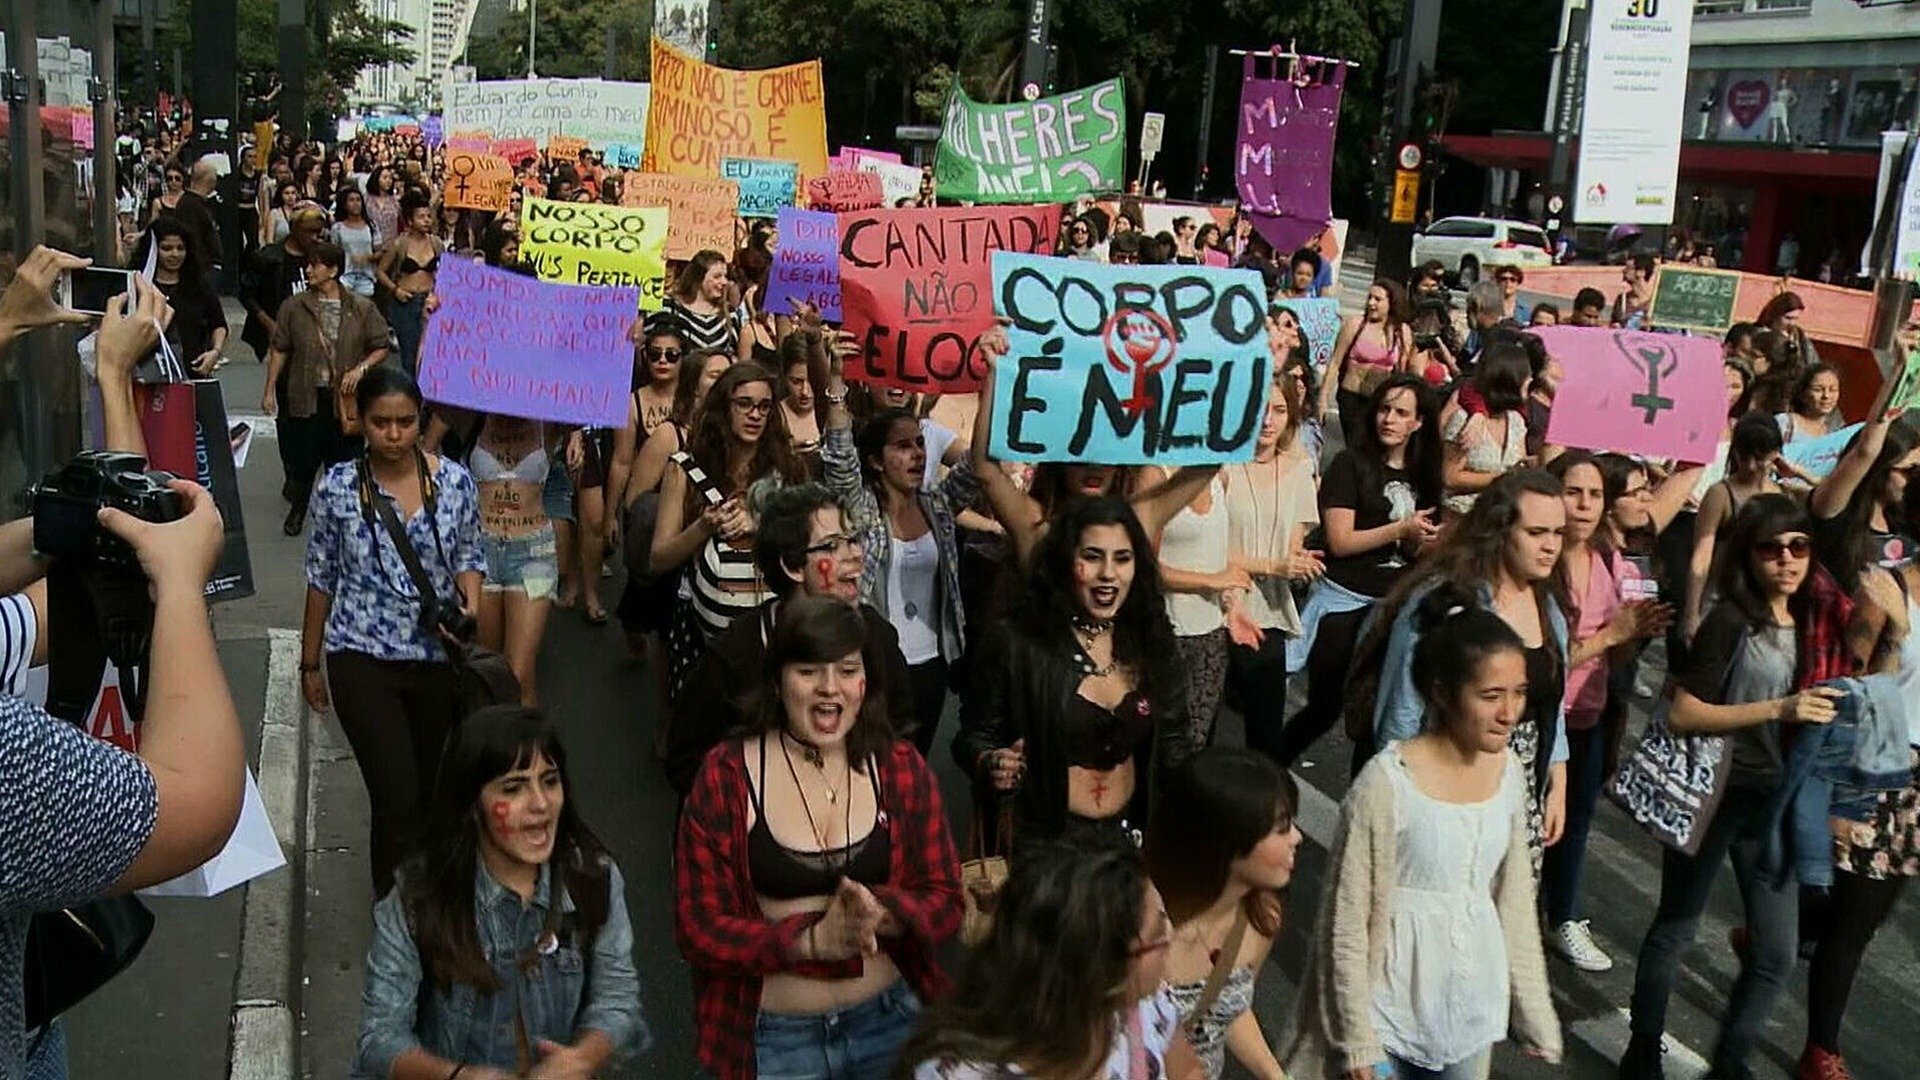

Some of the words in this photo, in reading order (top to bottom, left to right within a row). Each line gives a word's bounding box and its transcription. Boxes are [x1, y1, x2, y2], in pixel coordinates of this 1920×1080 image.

[453, 83, 538, 107] Eduardo
[943, 81, 1119, 165] MULHERES
[725, 160, 752, 179] EU
[529, 203, 645, 235] NOSSO
[530, 225, 641, 254] CORPO
[841, 215, 1052, 270] CANTADA
[577, 260, 664, 300] PERTENCE
[903, 271, 978, 316] NÃO
[1002, 267, 1265, 344] CORPO
[1007, 336, 1064, 454] É
[1068, 356, 1266, 457] MEU
